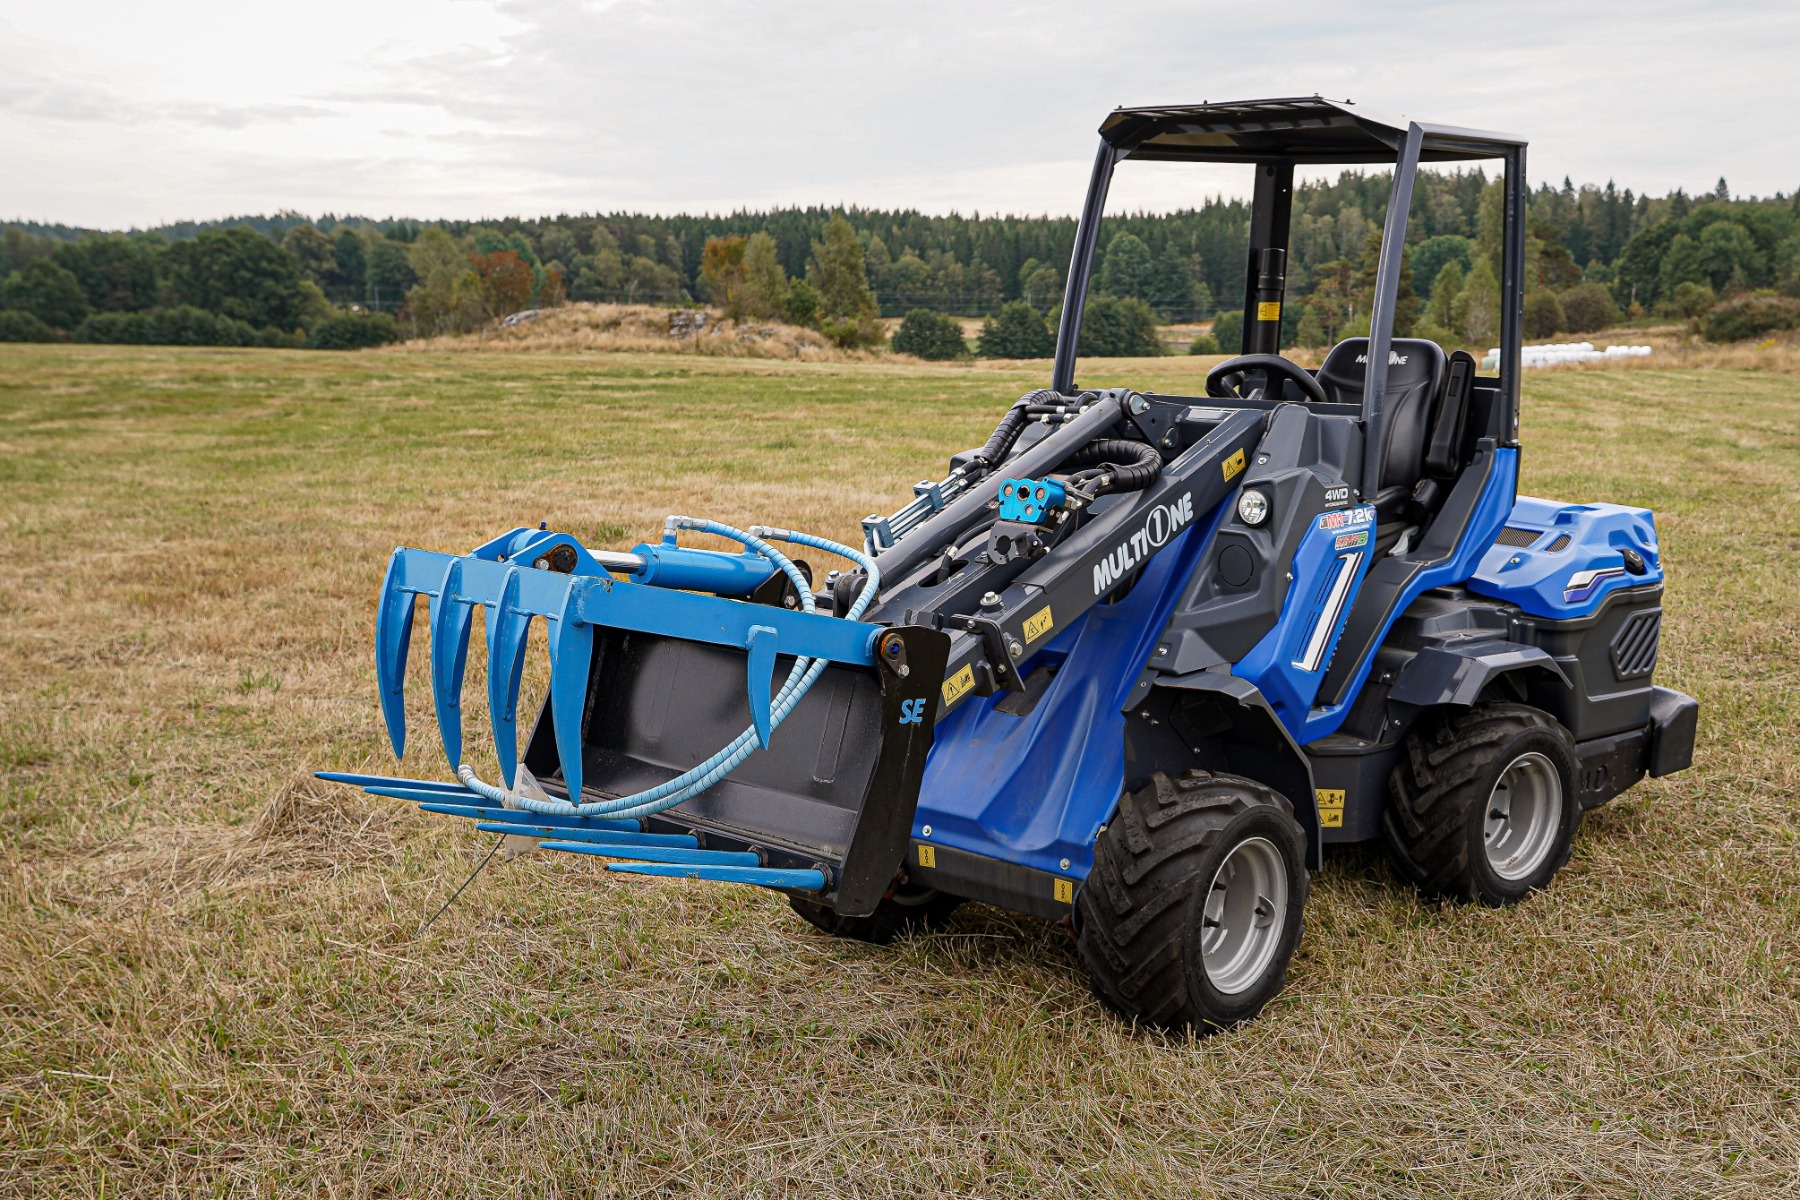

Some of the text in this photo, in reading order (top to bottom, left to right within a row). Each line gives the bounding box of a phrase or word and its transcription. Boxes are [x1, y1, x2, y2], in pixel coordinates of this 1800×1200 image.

[1325, 488, 1348, 501] 4WD
[1093, 491, 1194, 596] MULTIONE
[899, 698, 927, 725] SE
